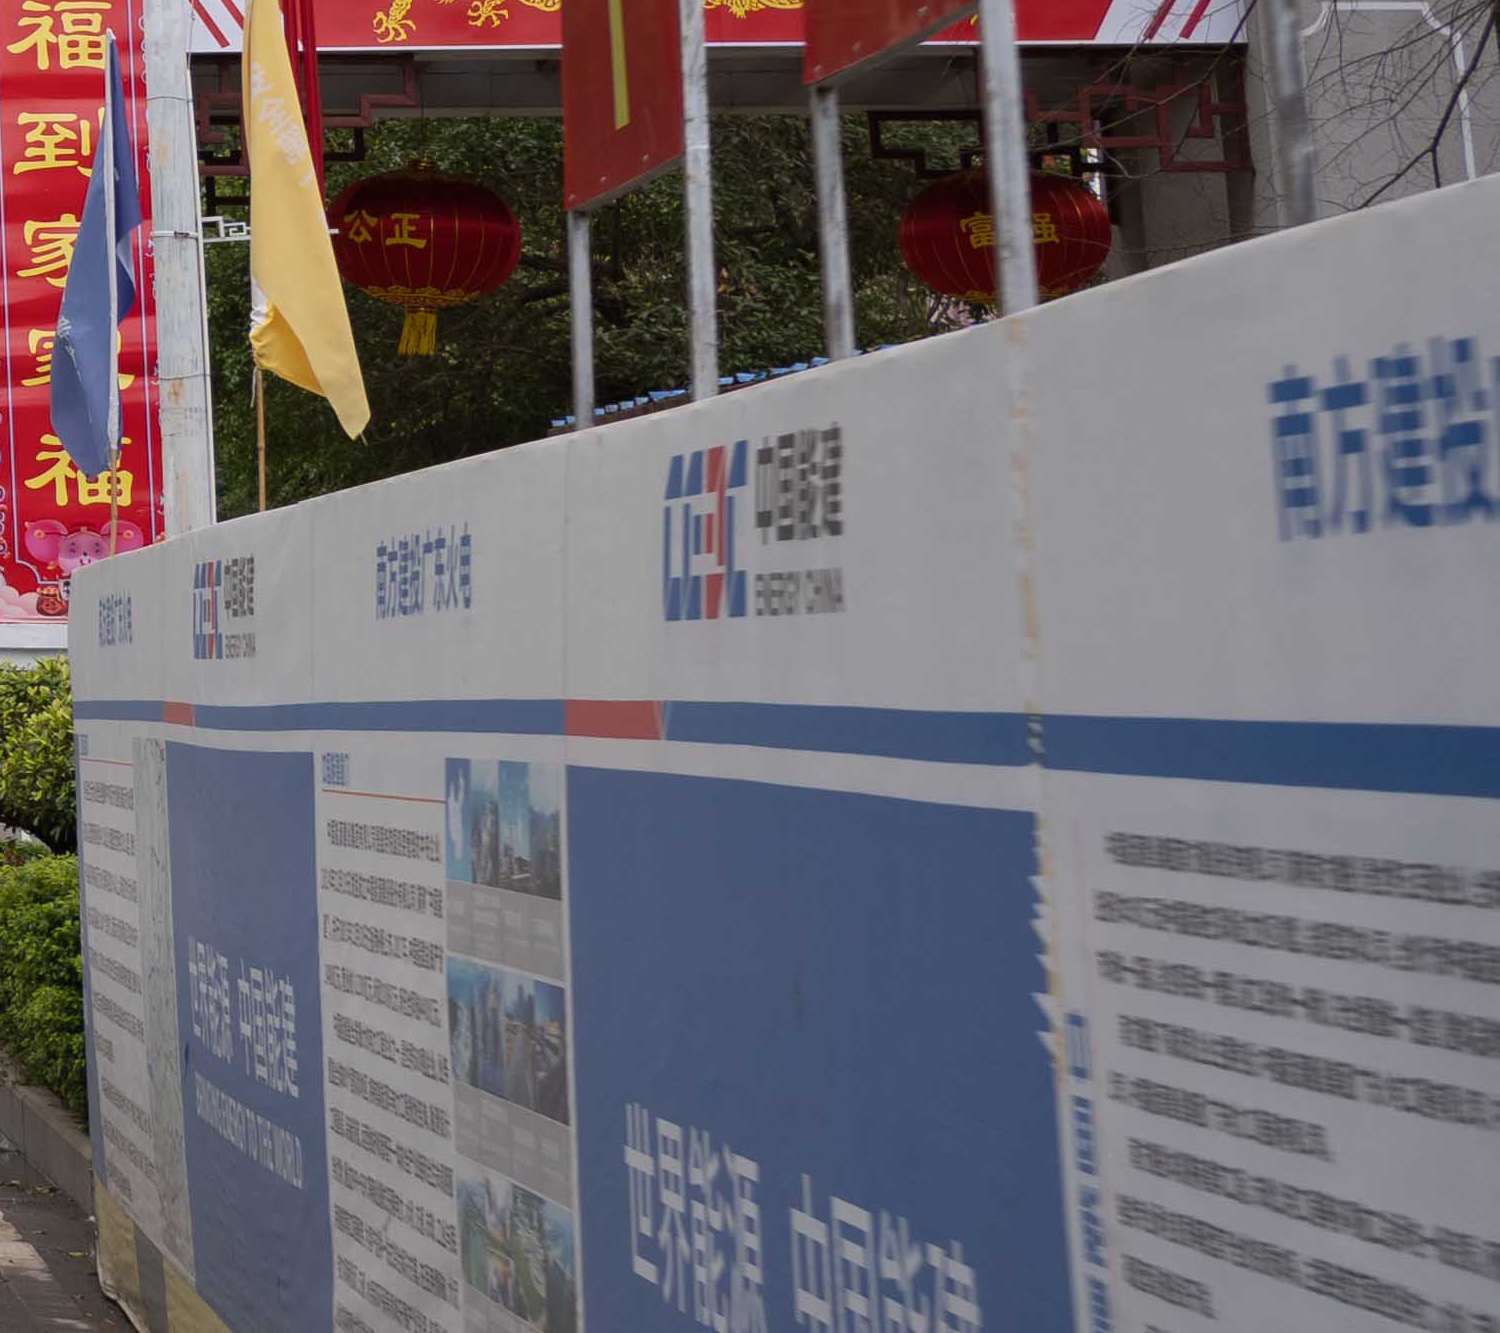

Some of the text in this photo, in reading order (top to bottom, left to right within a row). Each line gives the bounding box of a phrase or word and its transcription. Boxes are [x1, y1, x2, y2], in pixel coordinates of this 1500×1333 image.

[343, 208, 428, 250] 公正
[1266, 335, 1500, 543] 南方建投
[237, 957, 299, 1099] 中国能建
[623, 1102, 768, 1333] 世界能源
